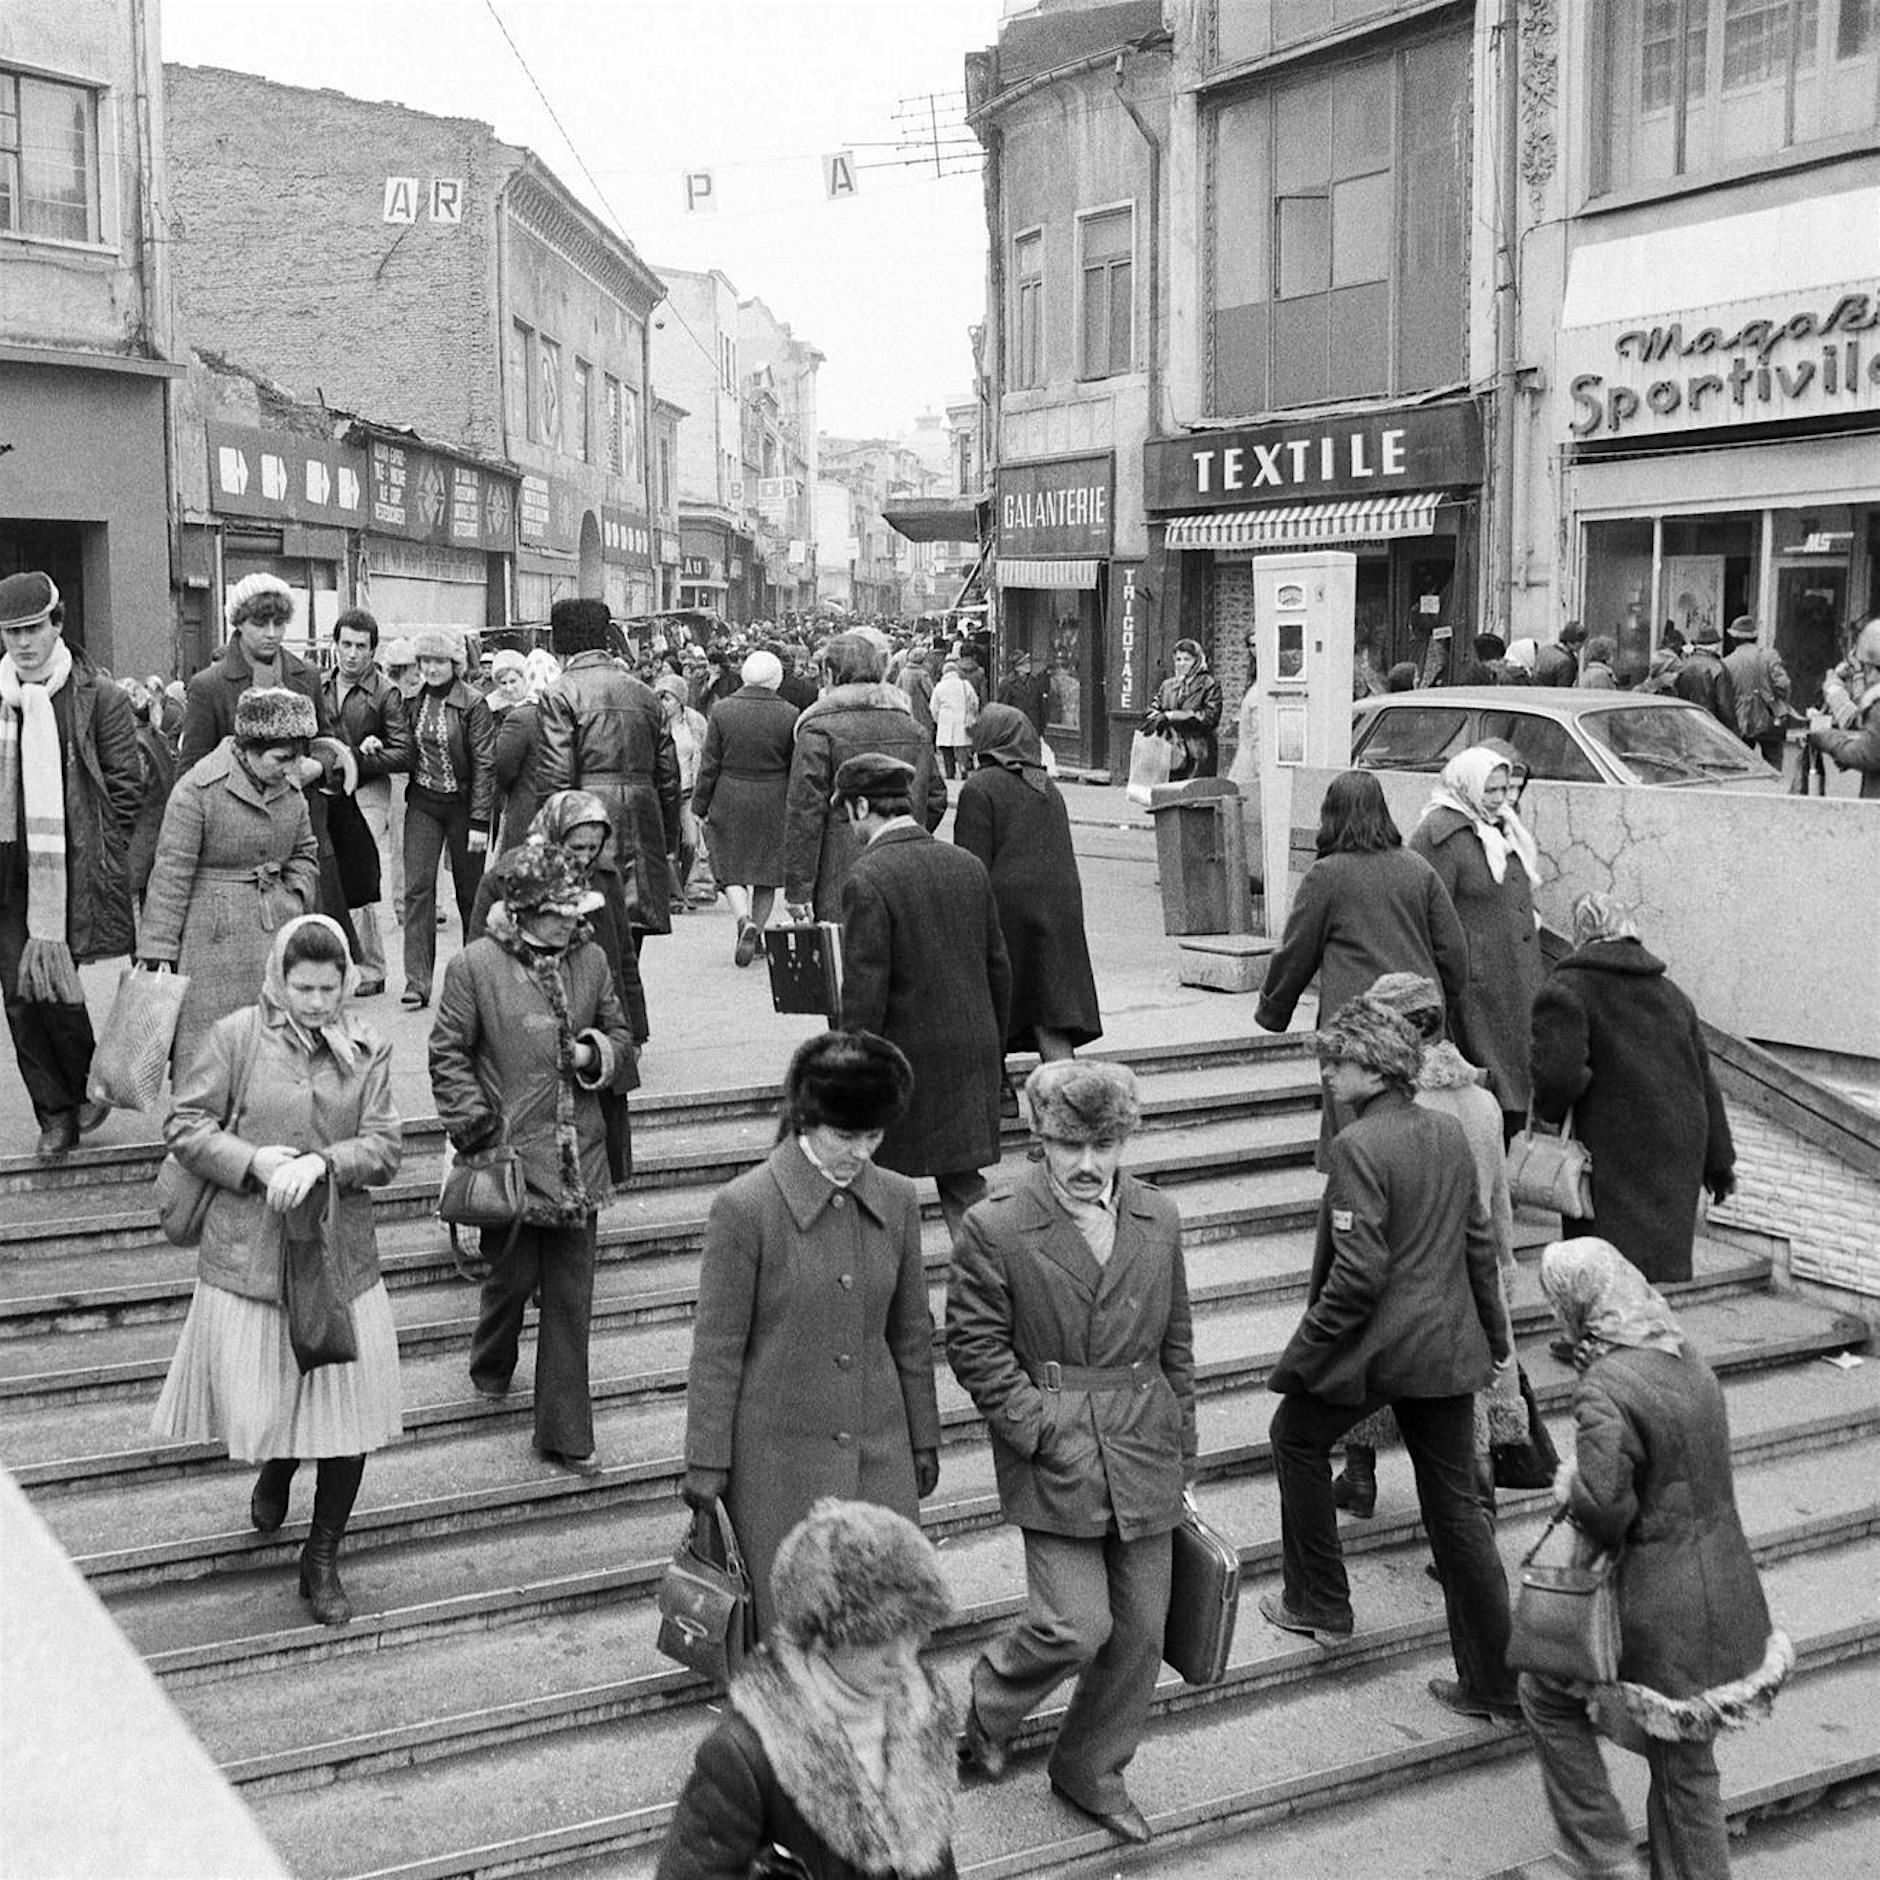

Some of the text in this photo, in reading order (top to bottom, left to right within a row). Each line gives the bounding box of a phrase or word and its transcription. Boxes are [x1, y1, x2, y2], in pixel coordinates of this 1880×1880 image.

[1615, 293, 1880, 363] Magaz
[1193, 429, 1405, 493] TEXTILE
[1004, 486, 1105, 529] GALANTERIE
[1121, 569, 1136, 708] TRICOTAJE
